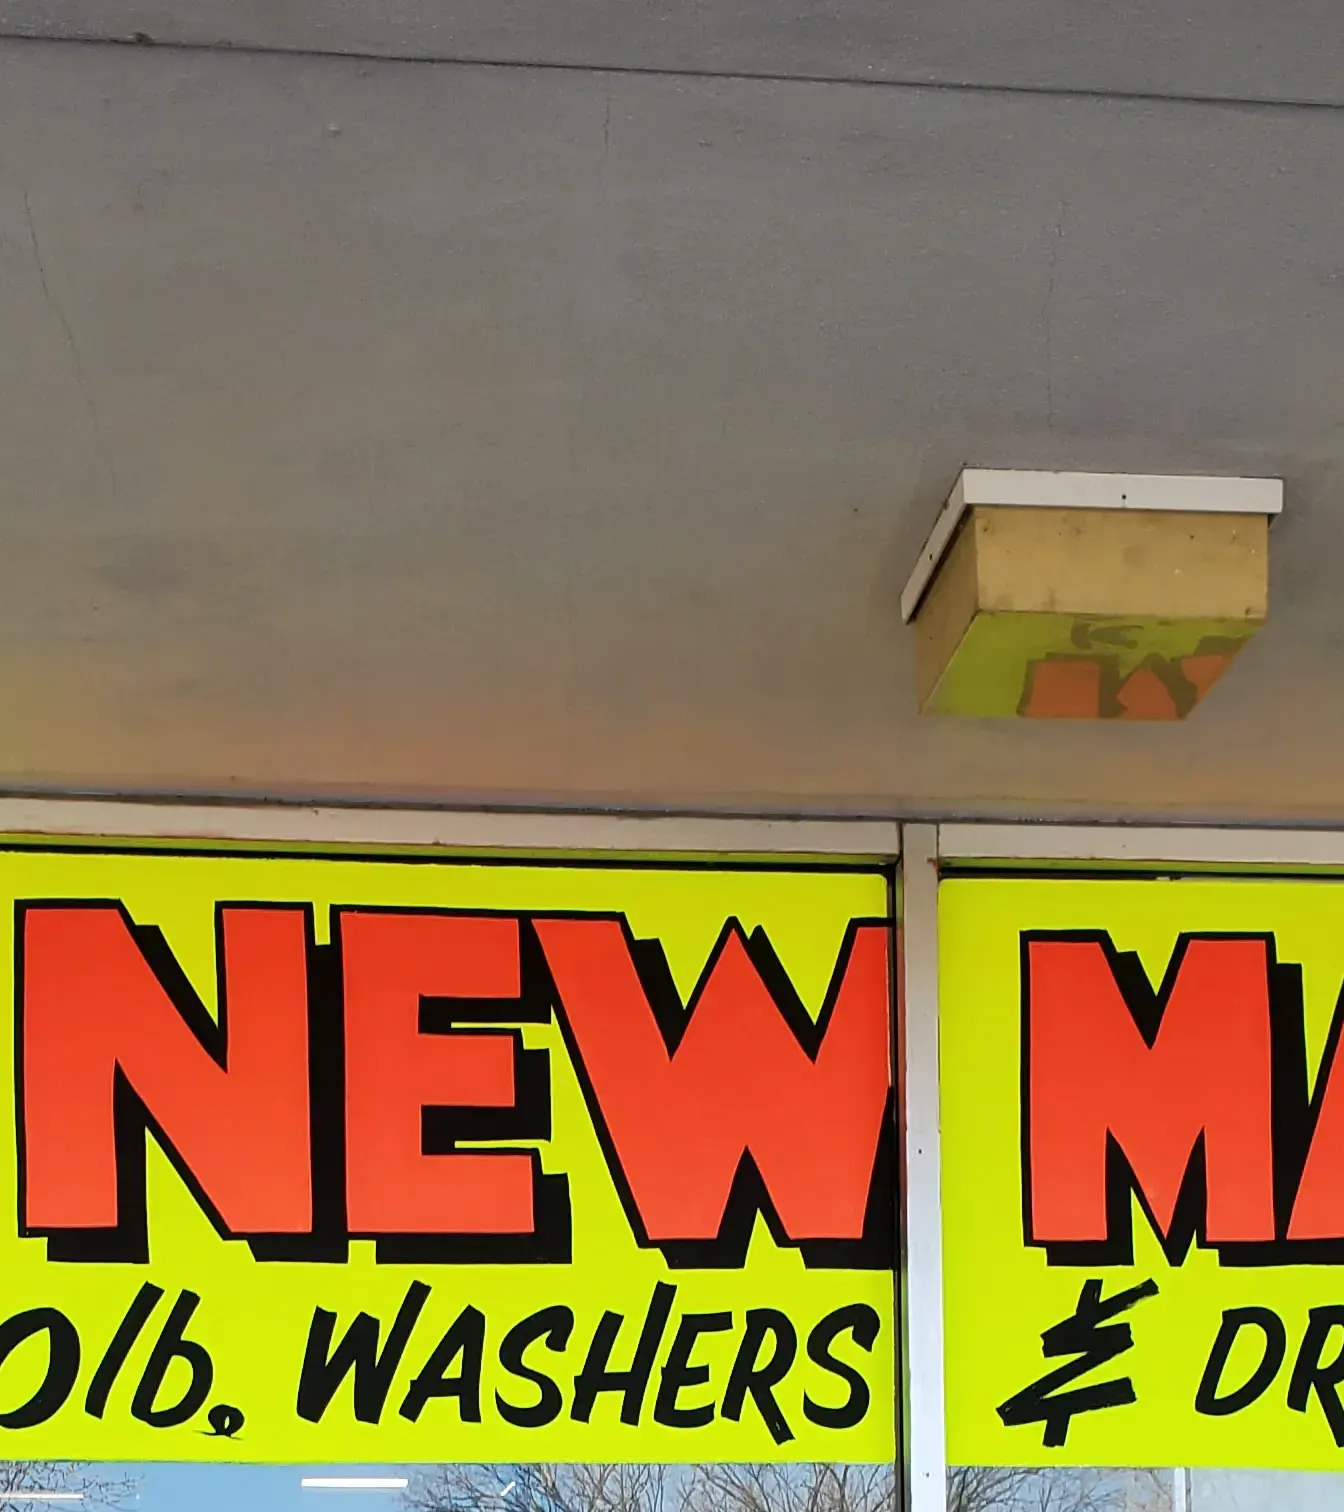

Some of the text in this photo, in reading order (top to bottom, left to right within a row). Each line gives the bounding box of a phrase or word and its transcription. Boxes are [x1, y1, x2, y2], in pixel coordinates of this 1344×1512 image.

[14, 897, 894, 1271] NEW
[295, 1280, 882, 1445] WASHERS
[996, 1278, 1159, 1447] &
